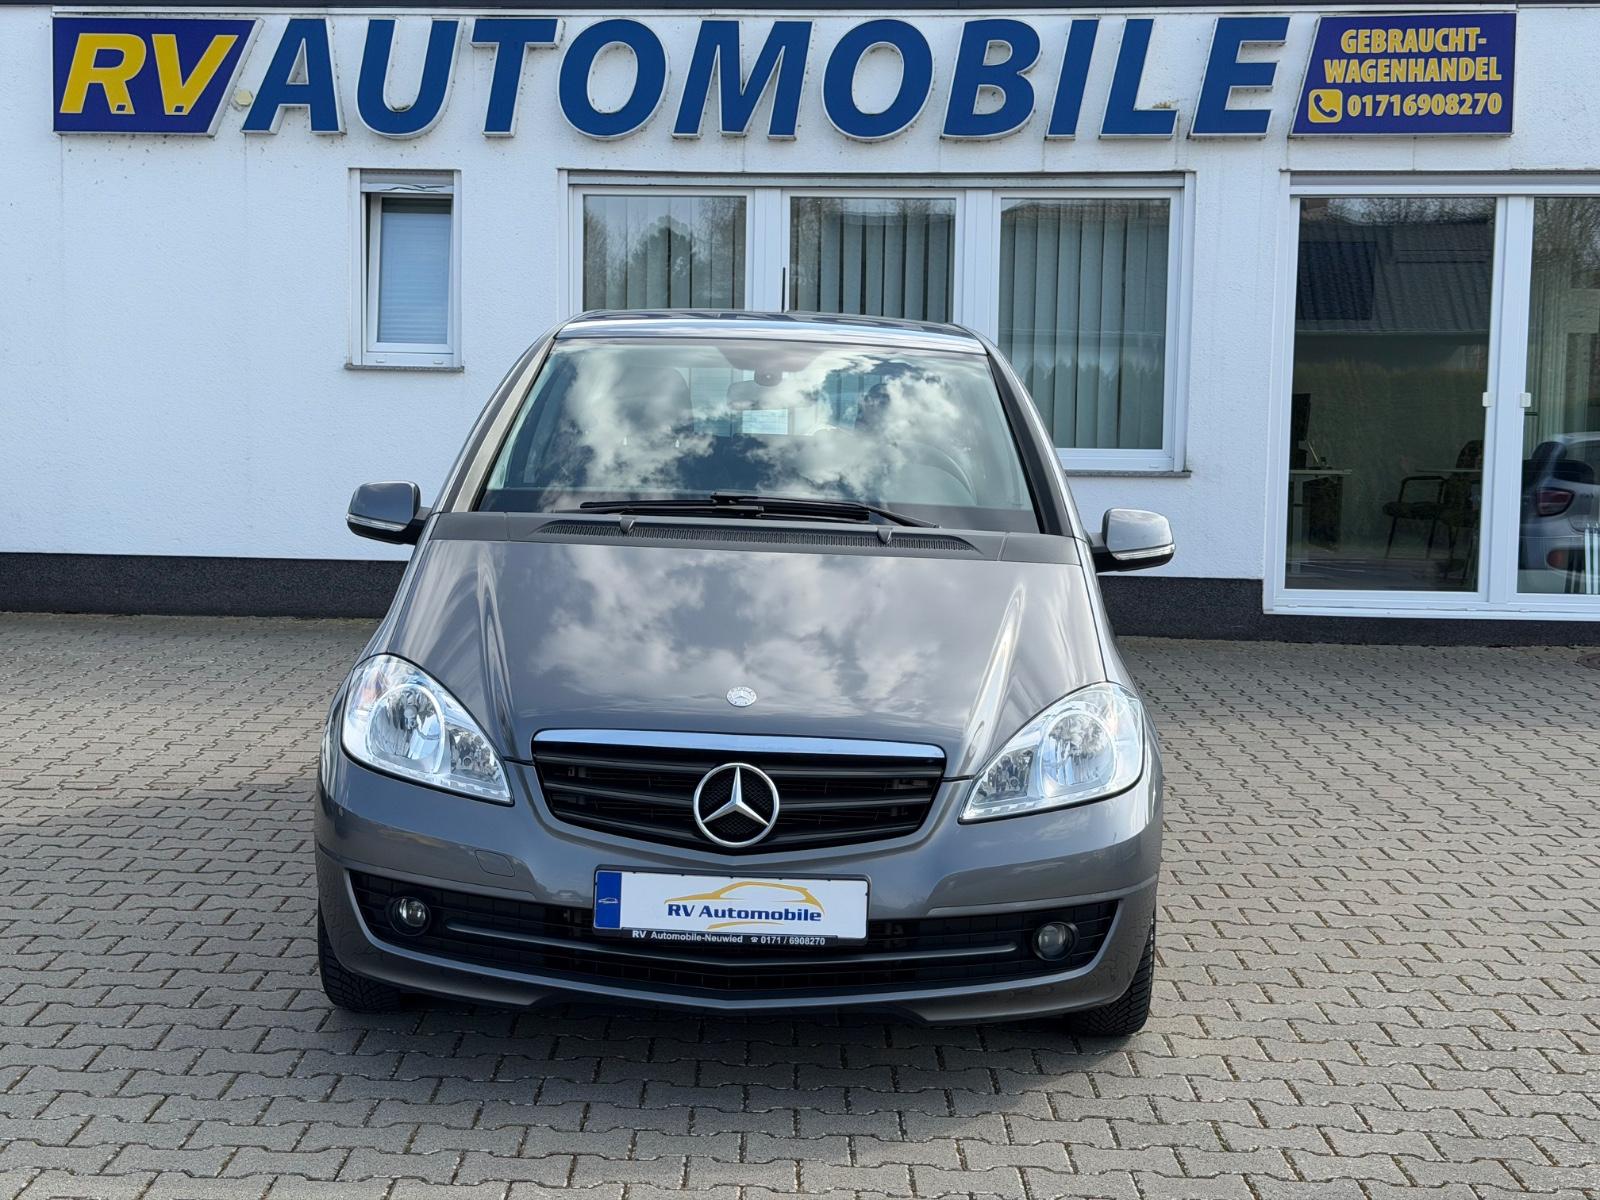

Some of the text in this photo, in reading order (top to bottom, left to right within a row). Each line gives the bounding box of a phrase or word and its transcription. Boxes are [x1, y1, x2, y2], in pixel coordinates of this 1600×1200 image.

[1341, 27, 1487, 53] GEBRAUCHT-
[241, 17, 1290, 142] AUTOMOBILE
[1324, 57, 1502, 83] WAGENHANDEL
[1347, 93, 1502, 116] 01716908270
[668, 904, 821, 921] RV Automobile
[632, 930, 646, 938] RV
[651, 931, 743, 943] Automobile-Neuwied
